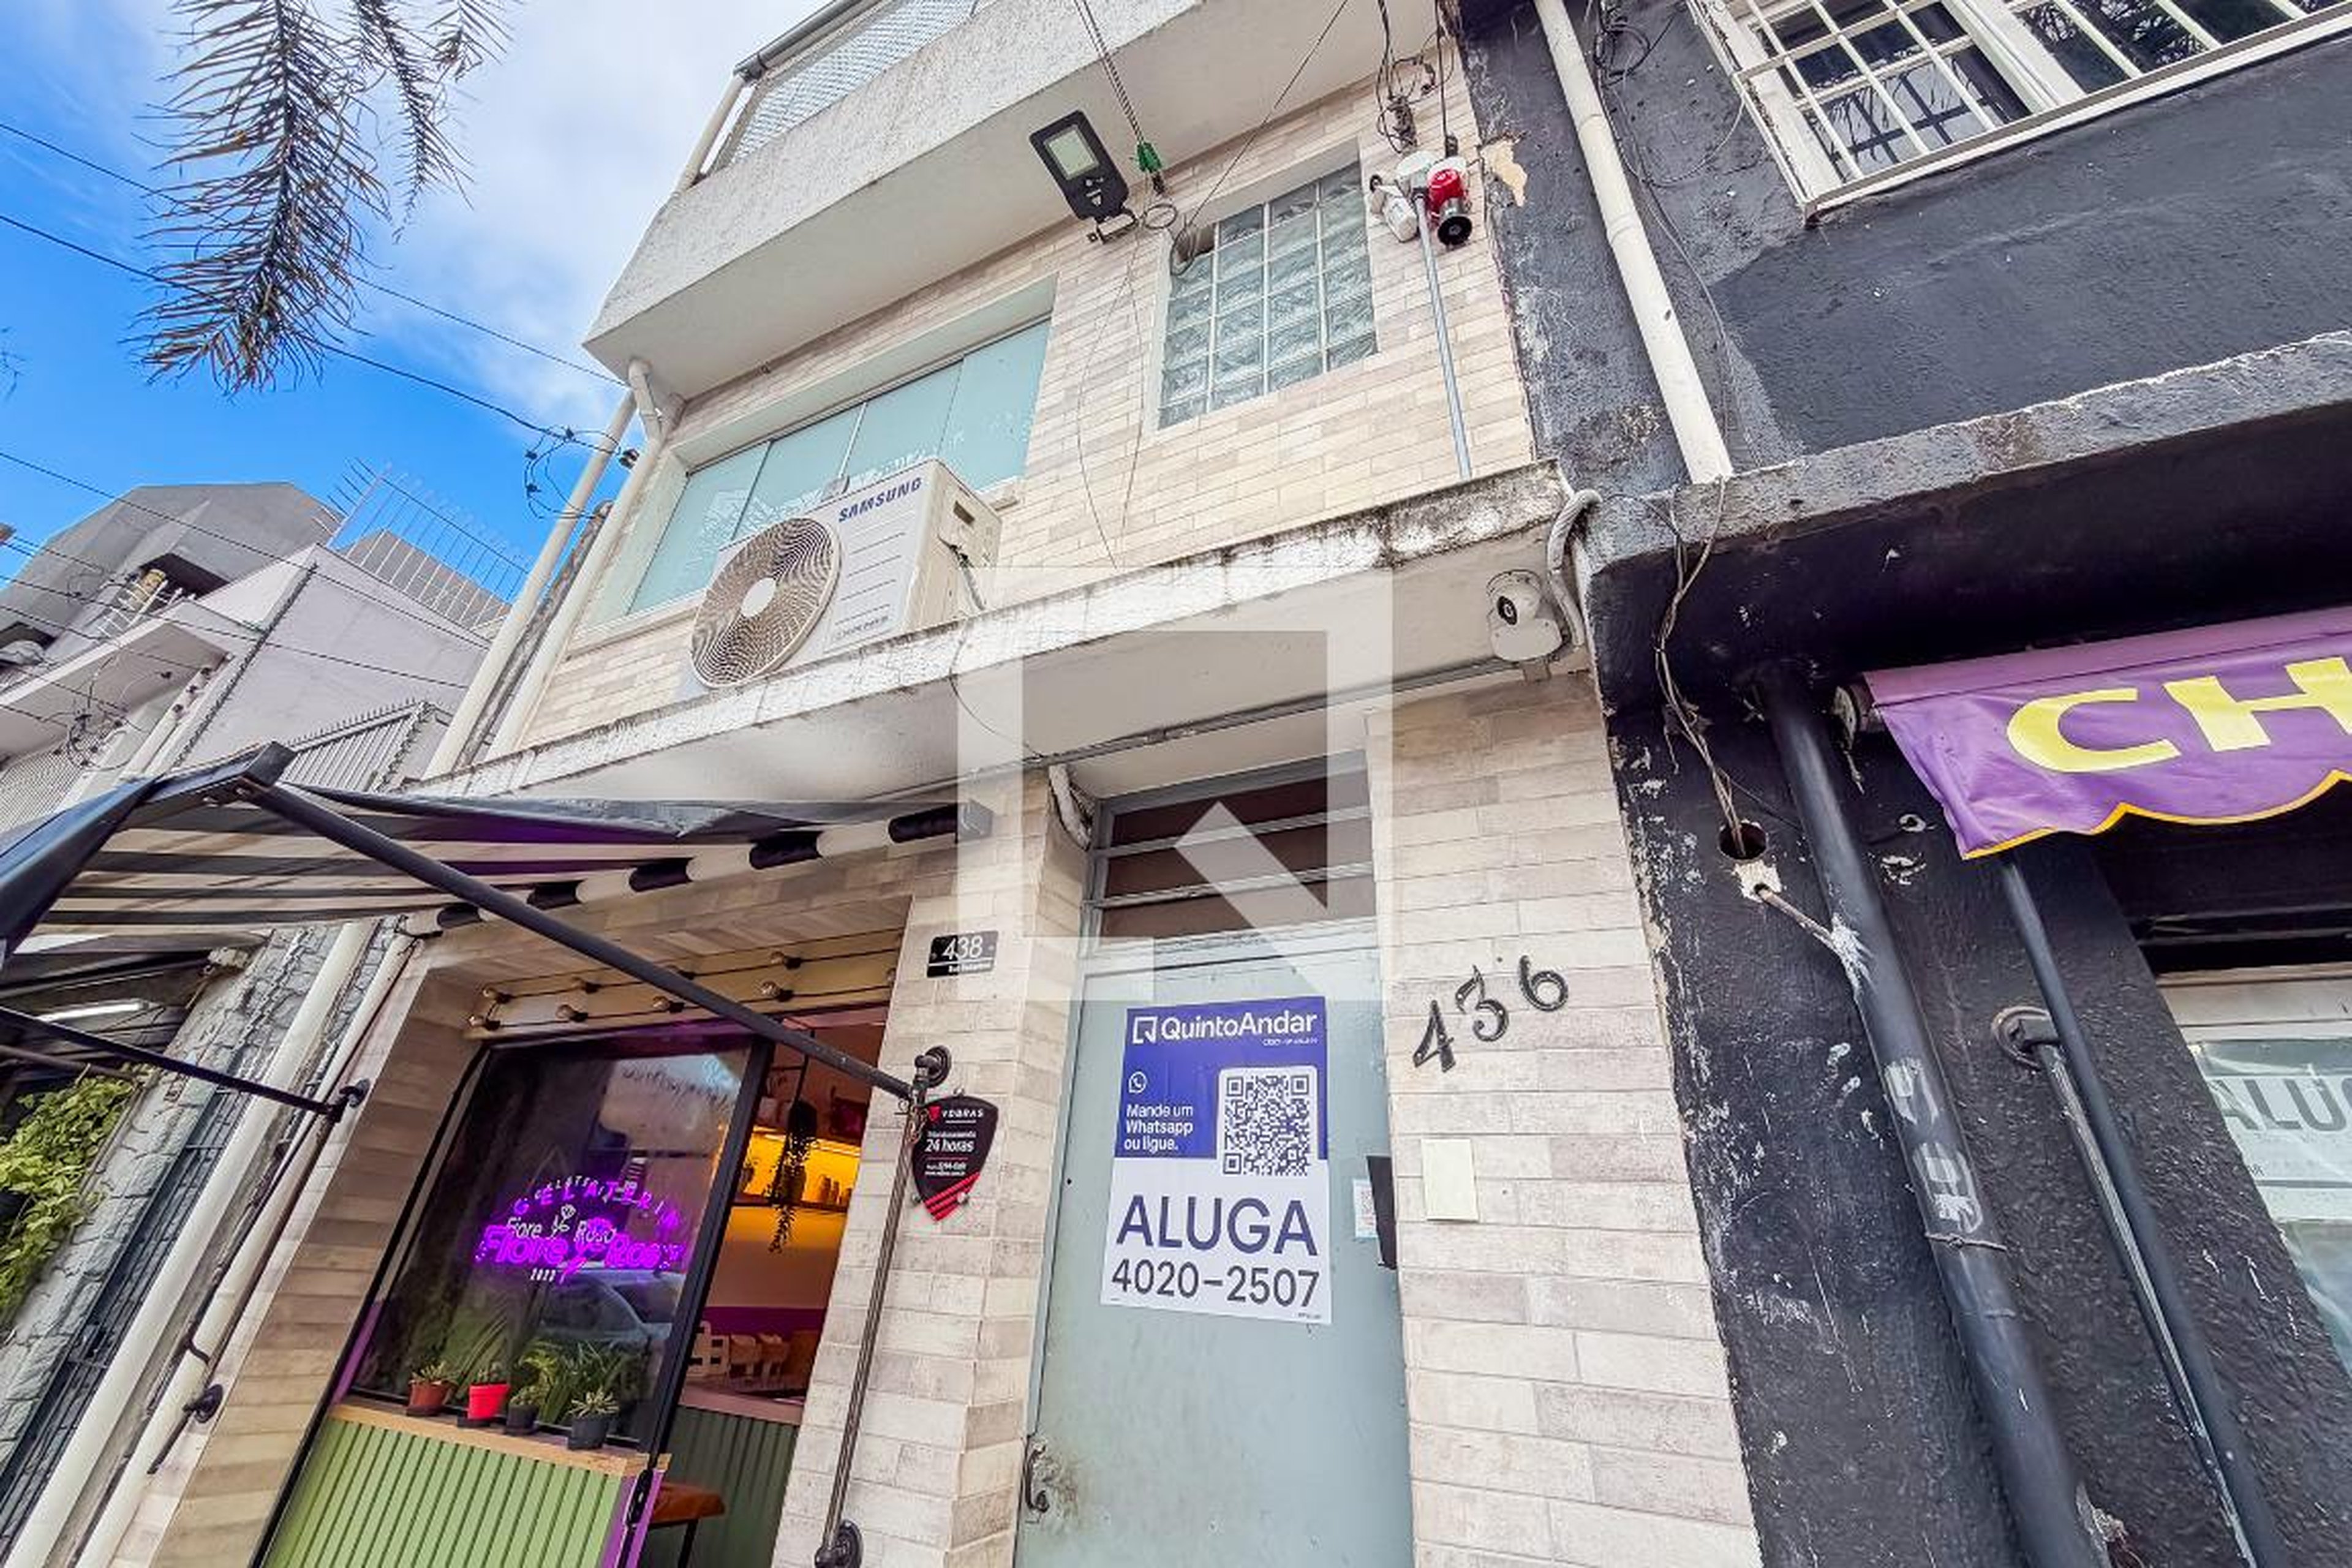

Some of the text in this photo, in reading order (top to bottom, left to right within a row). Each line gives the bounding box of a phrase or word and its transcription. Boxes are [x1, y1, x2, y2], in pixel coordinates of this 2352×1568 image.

[839, 477, 922, 522] SAMSUNG
[943, 936, 983, 960] 438
[1161, 1010, 1317, 1041] QuintoAndar
[1412, 956, 1568, 1072] 436
[1126, 1104, 1193, 1118] Mande um
[2207, 1079, 2352, 1131] ALU
[1126, 1120, 1193, 1136] Whatsapp
[924, 1139, 974, 1153] 24 horas
[1124, 1137, 1178, 1154] ou ligue.
[506, 1216, 543, 1240] Fiore
[1116, 1194, 1318, 1256] ALUGA
[484, 1224, 568, 1265] Fiore
[1112, 1258, 1320, 1308] 4020-2507
